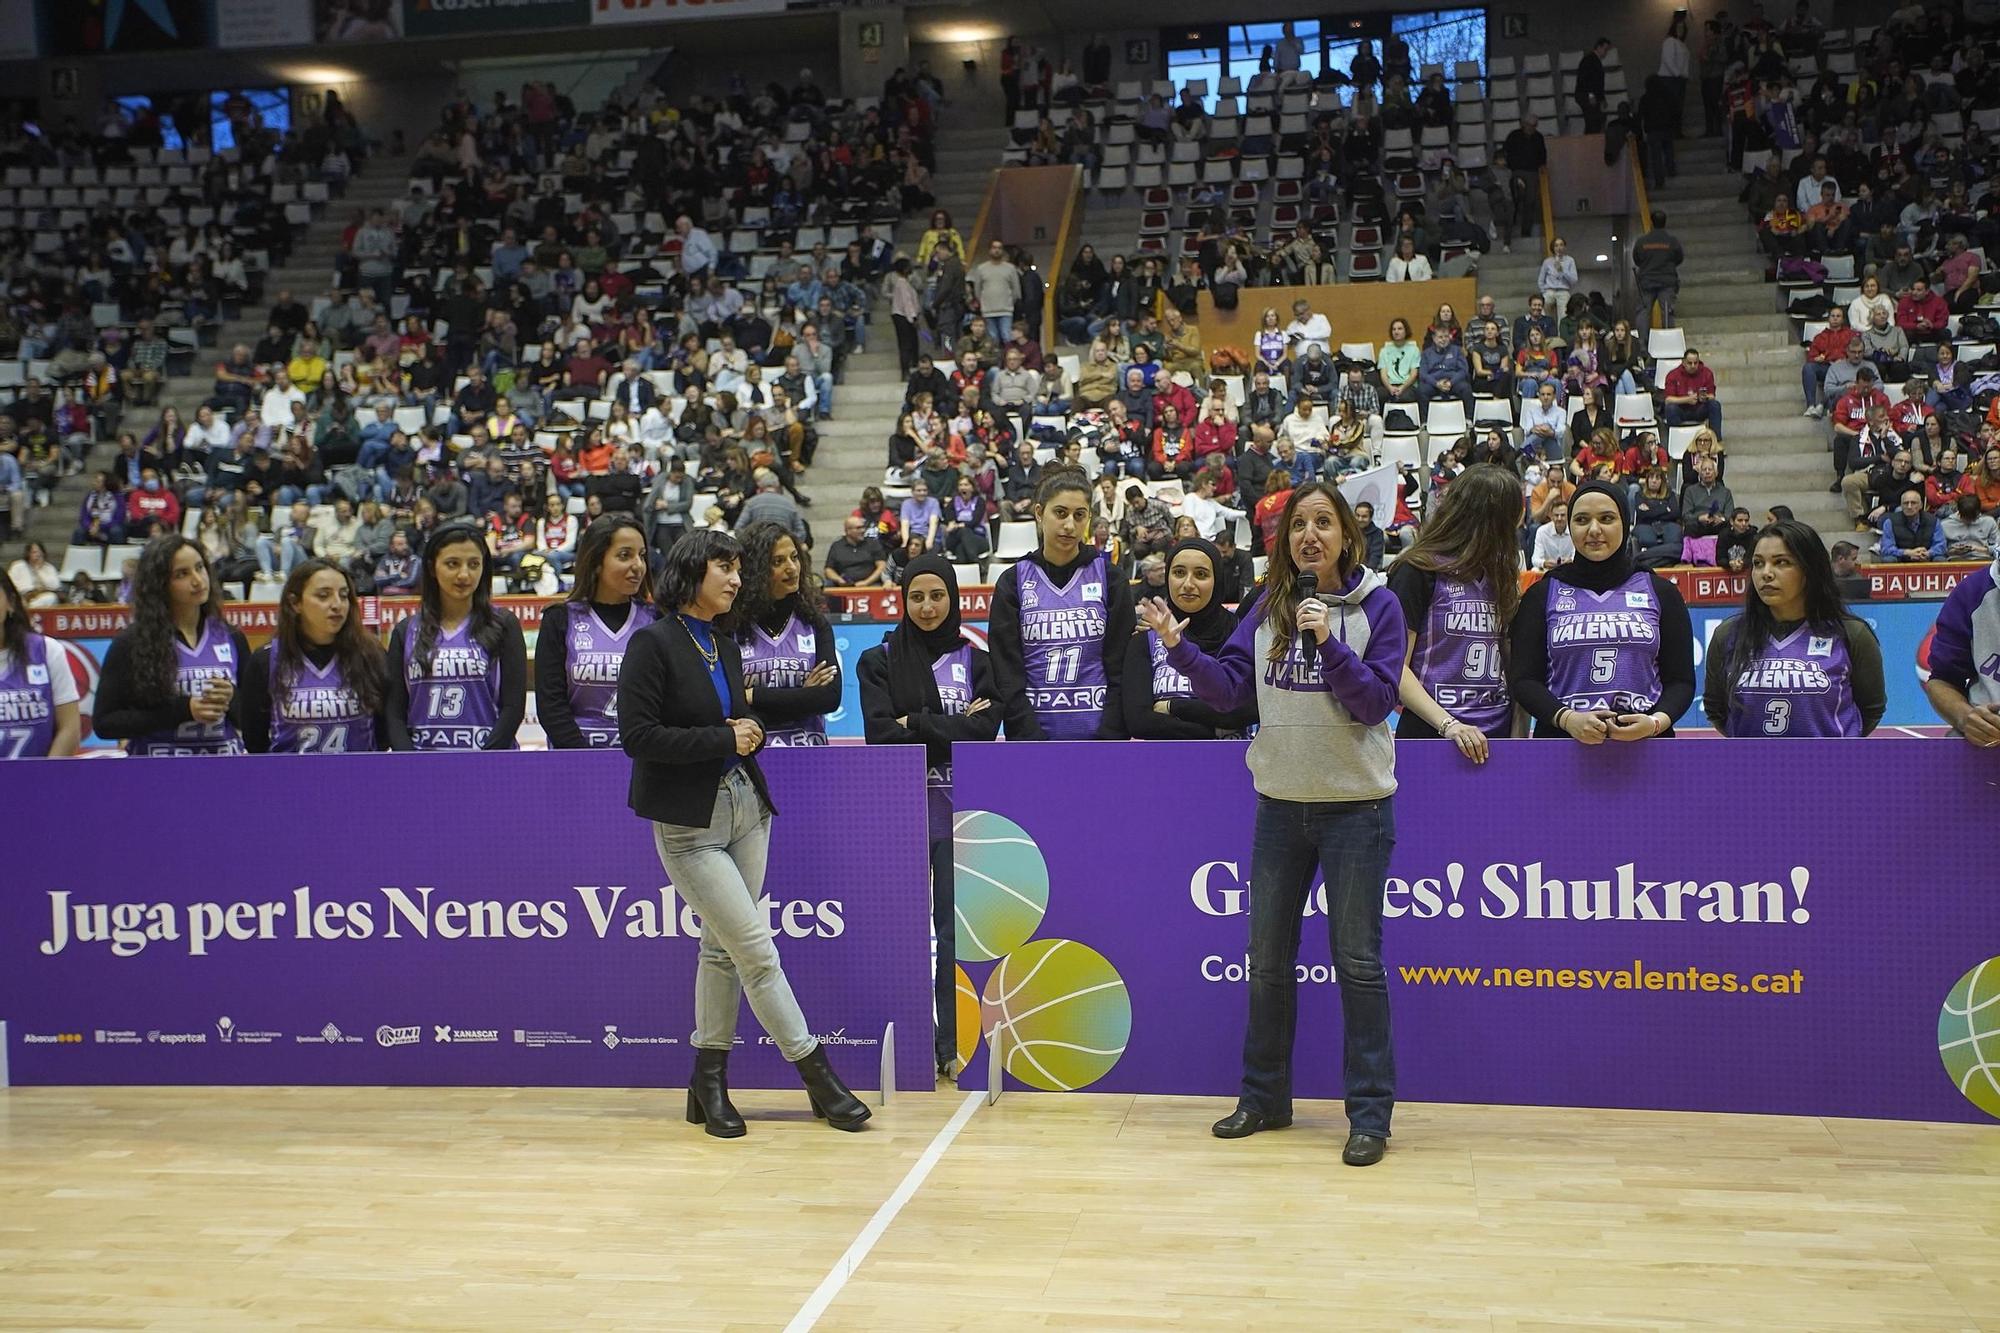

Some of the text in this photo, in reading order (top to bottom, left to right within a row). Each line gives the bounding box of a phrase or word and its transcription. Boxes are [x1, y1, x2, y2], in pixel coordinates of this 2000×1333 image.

[1026, 609, 1087, 625] UNIDES
[1453, 602, 1496, 614] UNIDE
[1022, 619, 1105, 641] VALENTES
[1446, 613, 1496, 634] VALEN
[1558, 613, 1631, 627] UNIDES
[1552, 622, 1654, 643] VALENTES
[407, 658, 488, 680] VAENTES
[579, 654, 622, 664] UNID
[1045, 646, 1082, 684] 11
[1590, 648, 1618, 684] 5
[1737, 669, 1829, 689] ALENTES
[427, 684, 466, 719] 13
[1762, 698, 1792, 735] 3
[297, 725, 349, 755] 24
[1479, 861, 1810, 925] Shukran!
[40, 885, 845, 957] Juga per les Nenes Valetes
[1399, 959, 1806, 995] www.nenesvalentes.cat
[160, 1031, 207, 1045] esportcat
[394, 1027, 419, 1038] UNI
[453, 1030, 498, 1039] XANASCAT
